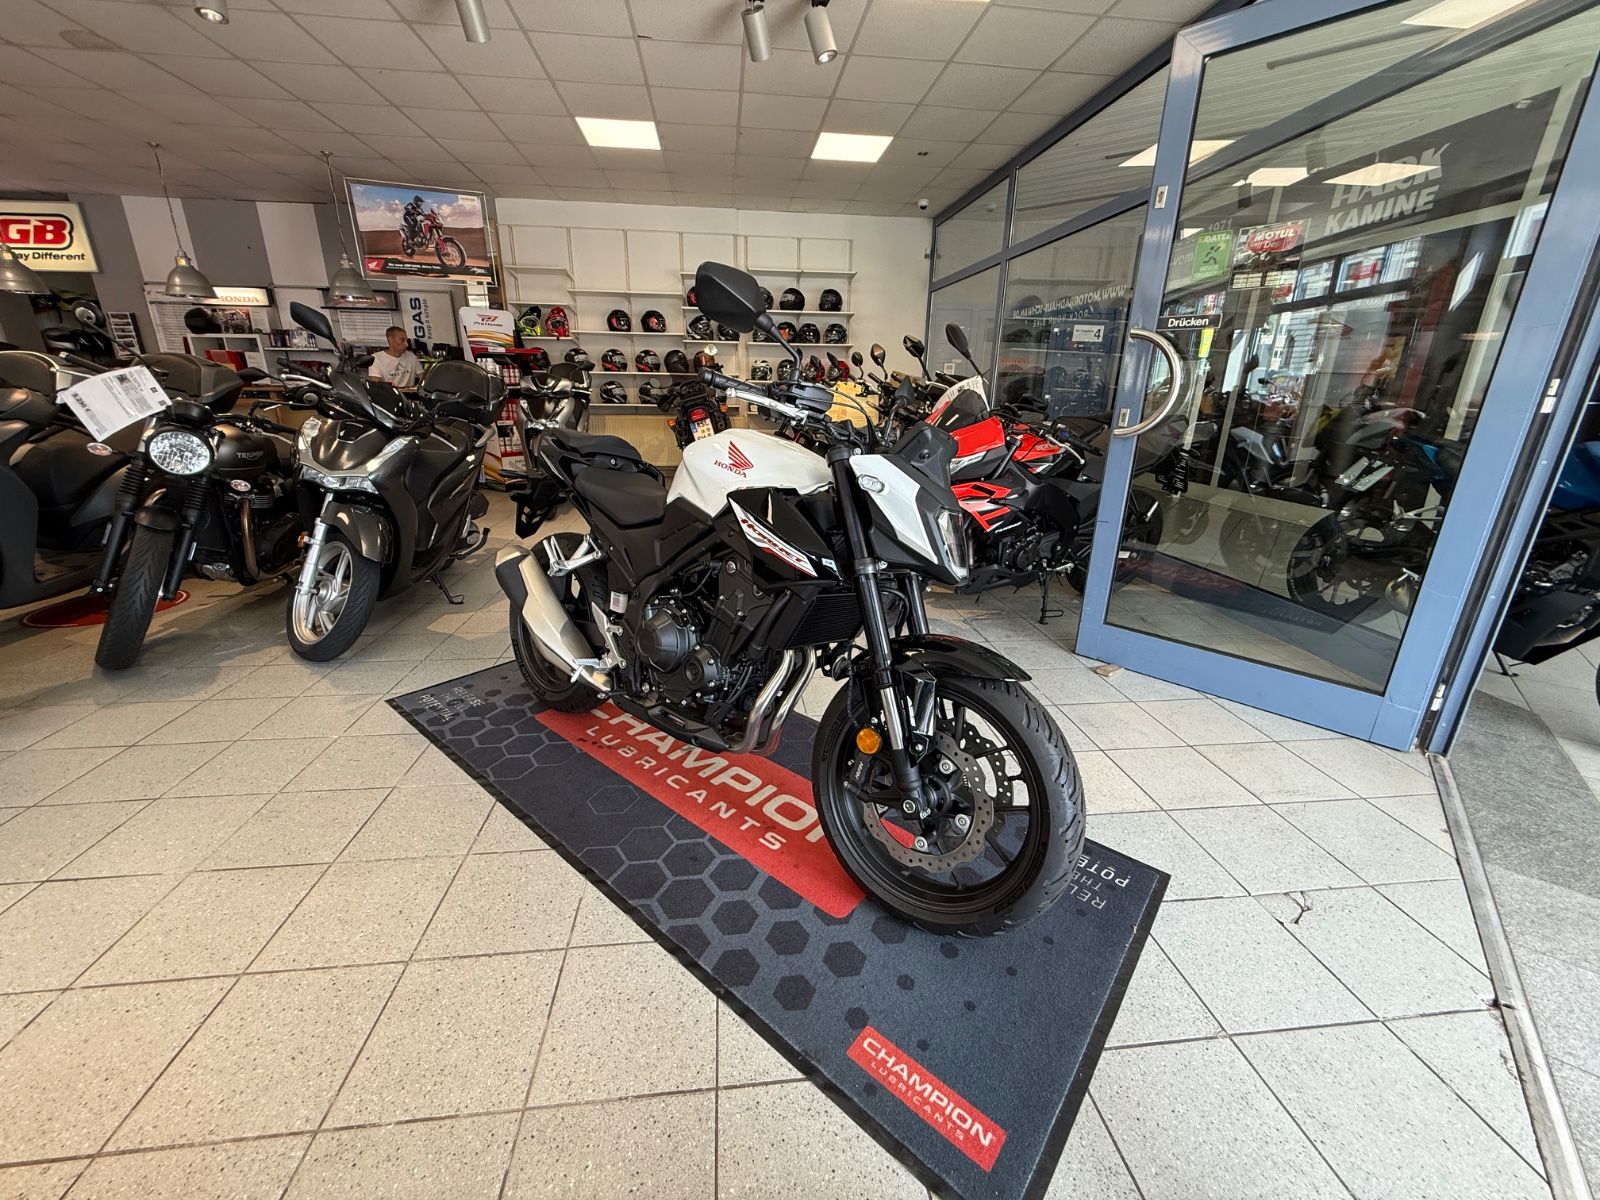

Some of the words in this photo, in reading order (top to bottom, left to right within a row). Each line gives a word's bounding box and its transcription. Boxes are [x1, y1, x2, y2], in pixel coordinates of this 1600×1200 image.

[1324, 185, 1439, 236] KAMINE
[1253, 229, 1294, 241] MOTUL
[32, 252, 85, 260] Different
[1168, 317, 1209, 327] Drücken
[1093, 328, 1102, 340] 4
[714, 459, 748, 478] HONDA
[586, 725, 787, 851] LUBRICANTS
[862, 1037, 994, 1147] CHAMPION
[871, 1061, 966, 1142] LUBRICANTS
